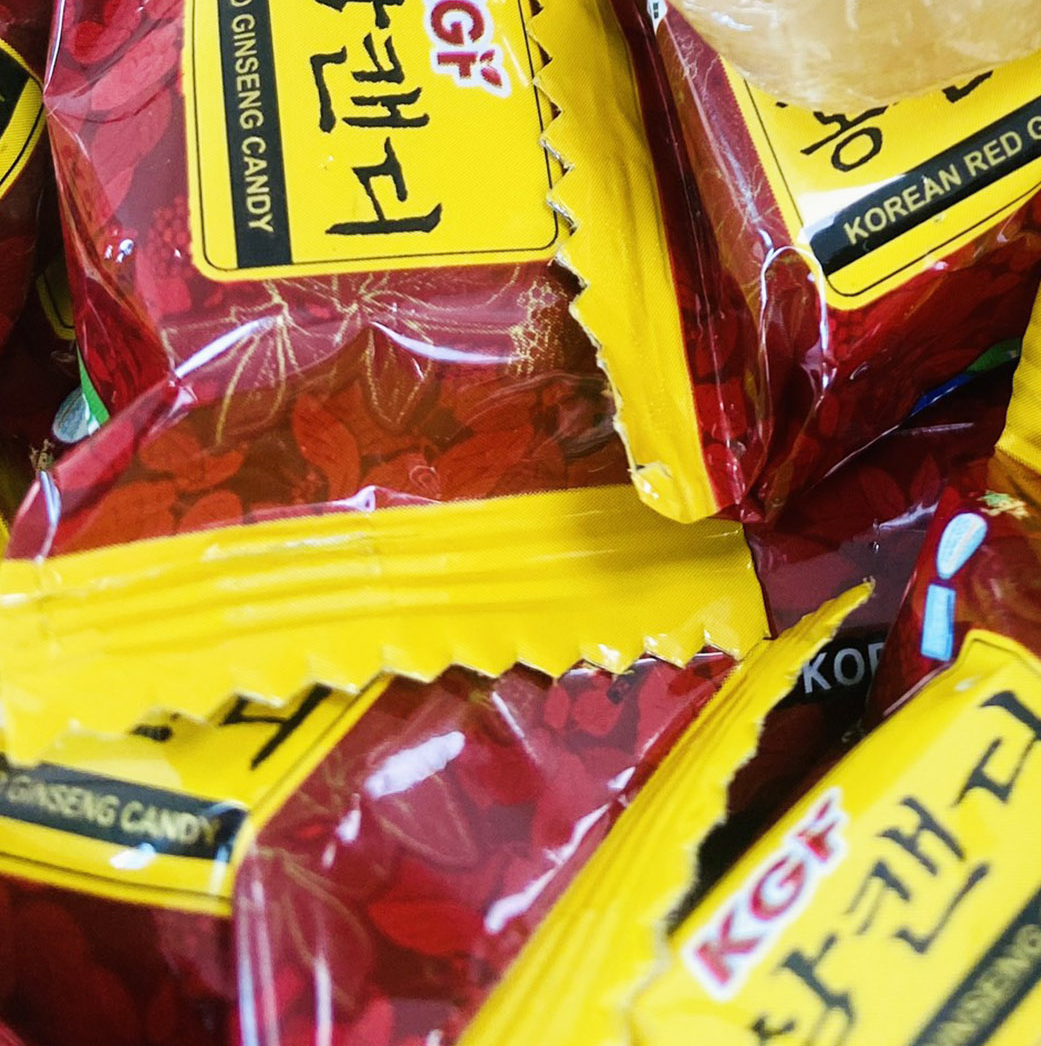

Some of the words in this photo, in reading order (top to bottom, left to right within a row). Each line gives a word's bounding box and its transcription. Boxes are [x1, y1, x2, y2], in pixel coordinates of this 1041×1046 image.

[231, 14, 265, 129] GINSENG
[241, 137, 274, 232] CANDY
[844, 163, 961, 245] KOREAN
[967, 130, 1023, 179] RED
[120, 801, 220, 846] CANDY
[694, 794, 842, 985] KGF
